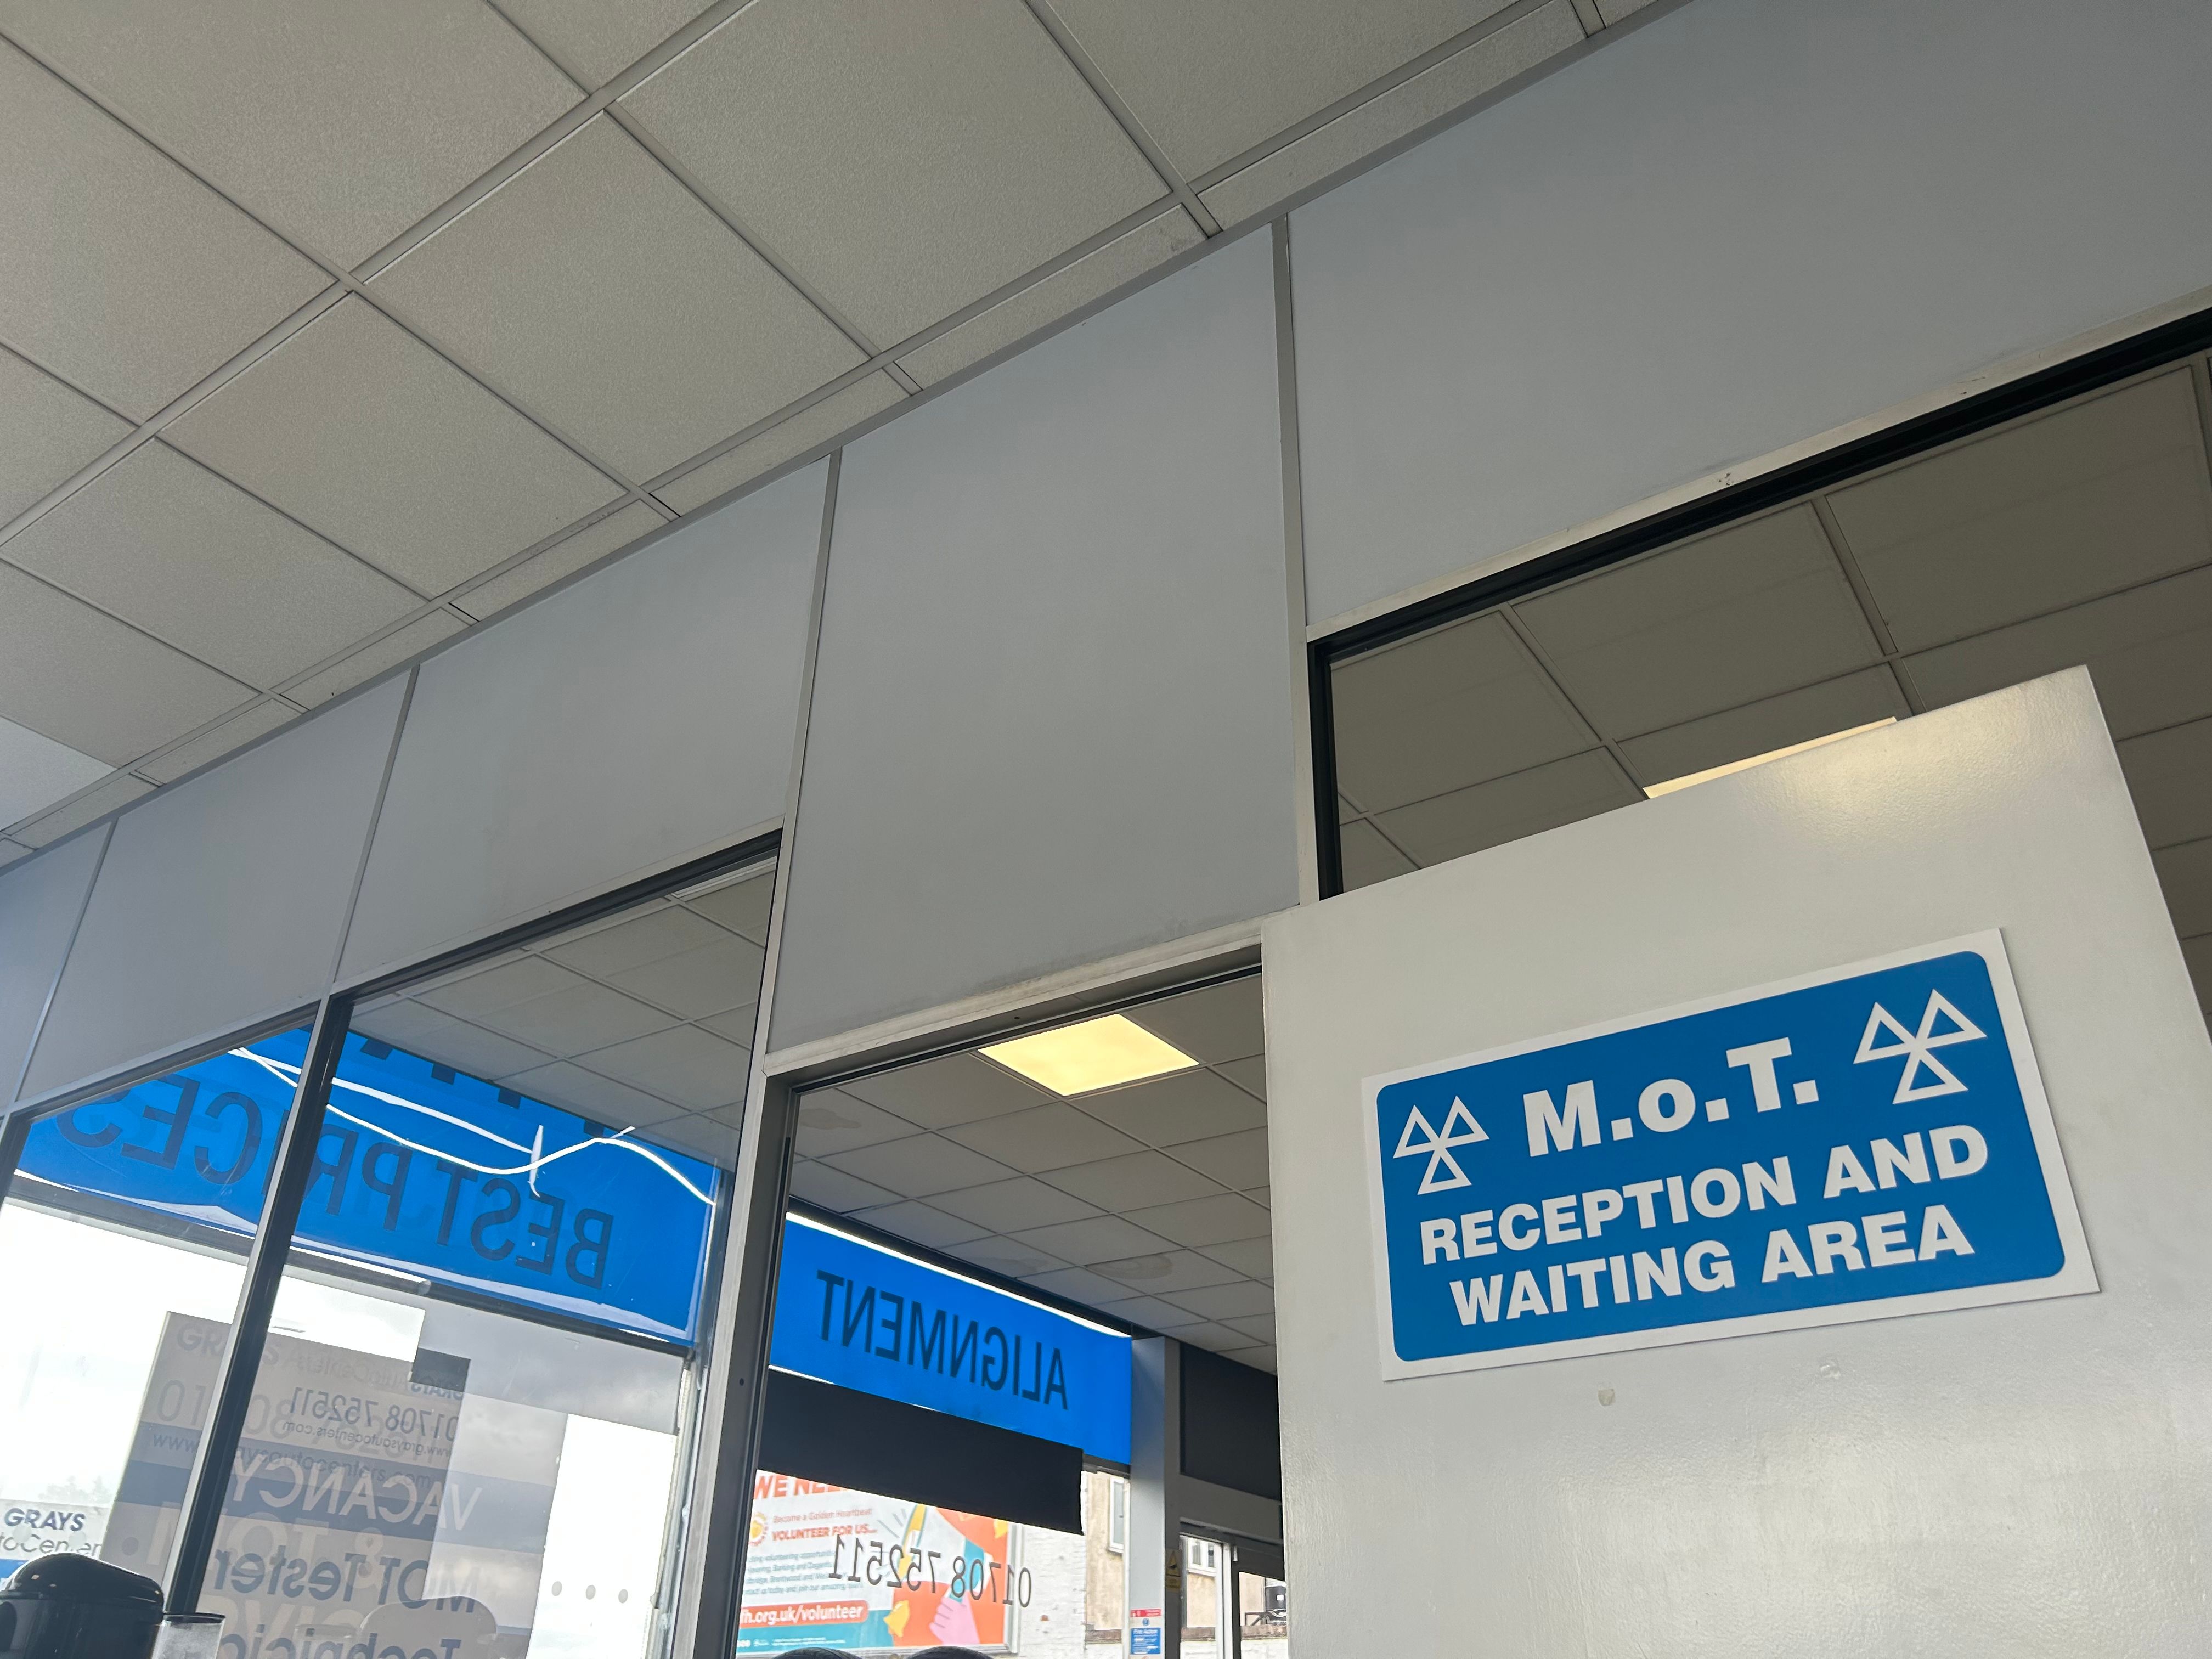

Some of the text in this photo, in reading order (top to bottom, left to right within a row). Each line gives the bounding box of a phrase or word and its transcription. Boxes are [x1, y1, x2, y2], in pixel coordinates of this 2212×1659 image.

[1523, 1037, 1819, 1157] M.o.T.
[1420, 1125, 1989, 1265] RECEPTION AND
[1450, 1204, 1975, 1327] WAITING AREA
[4, 1508, 86, 1532] GRAYS
[772, 1526, 830, 1541] VOLUNTEER
